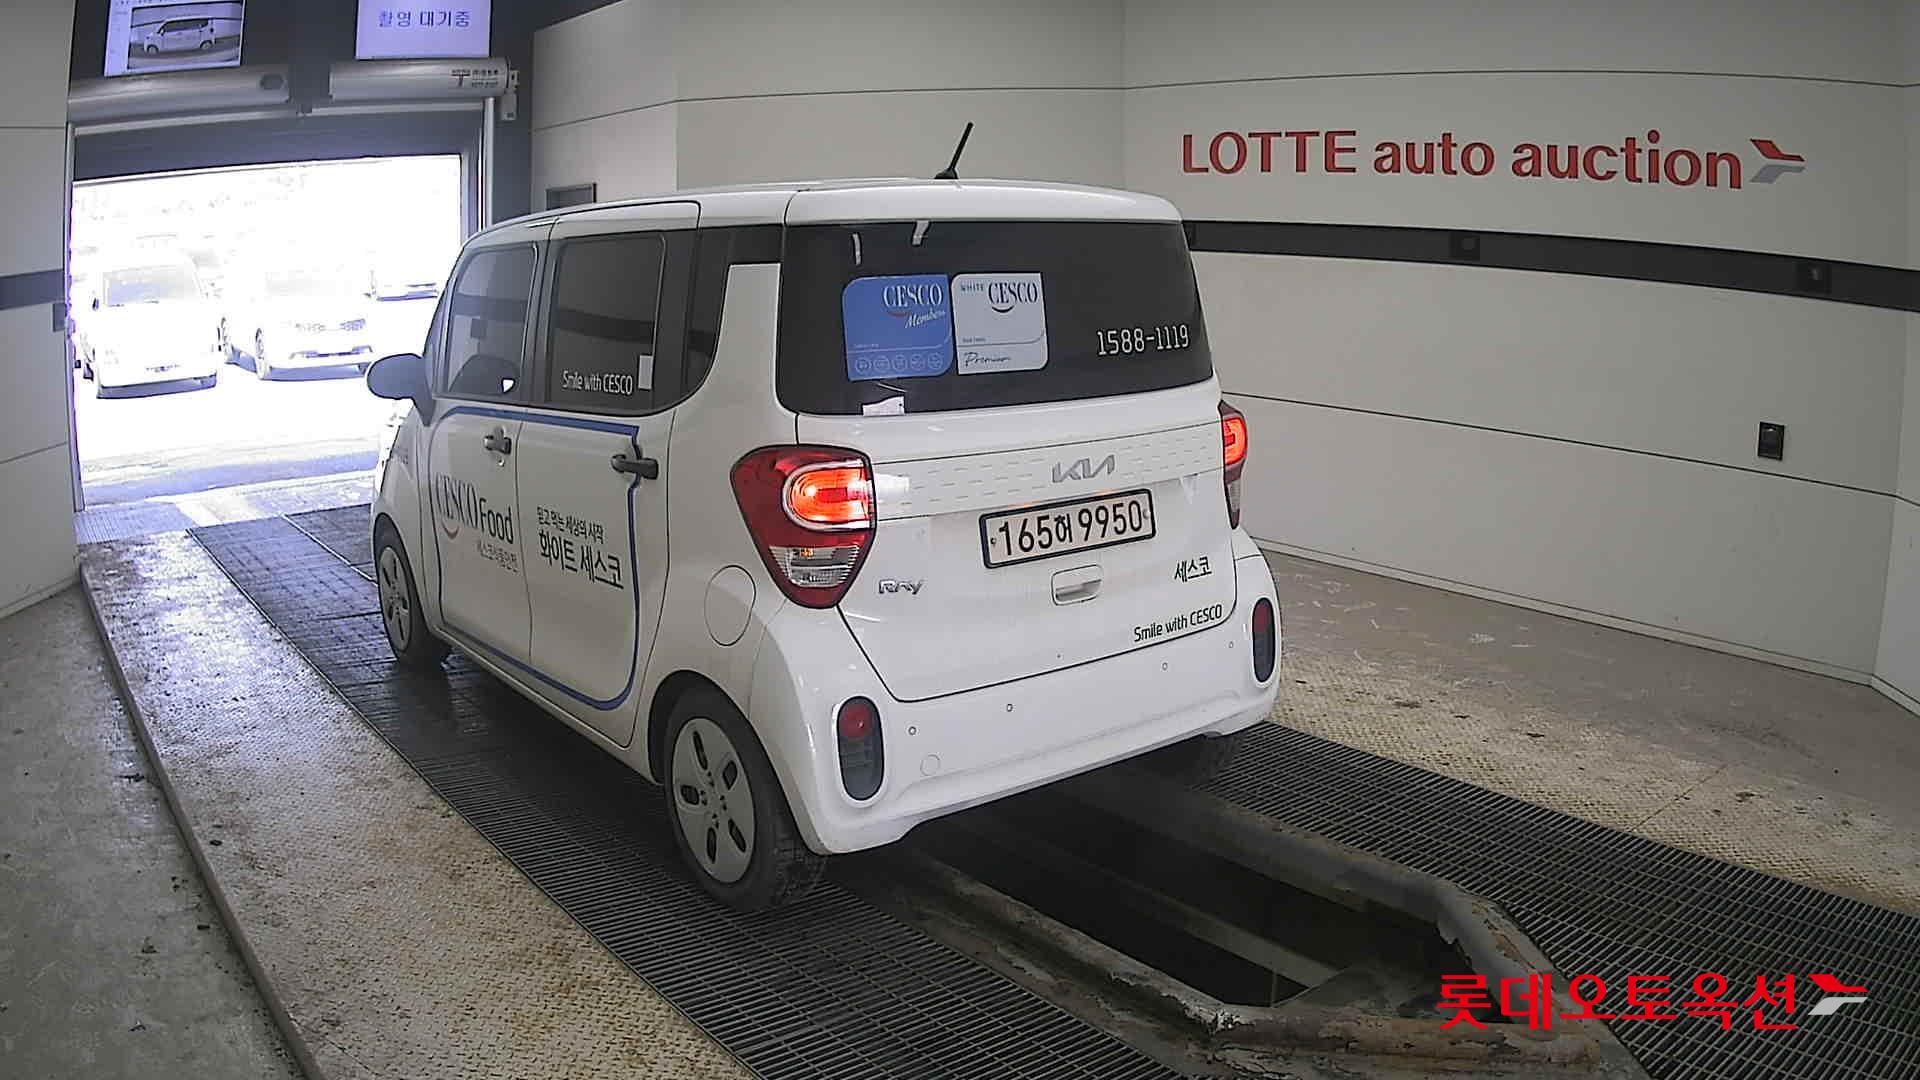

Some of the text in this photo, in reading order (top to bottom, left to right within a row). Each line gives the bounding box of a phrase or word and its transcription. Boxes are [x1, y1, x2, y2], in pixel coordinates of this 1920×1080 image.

[419, 10, 470, 28] 대기중
[1183, 129, 1742, 190] LOTTE auto auction
[883, 282, 943, 308] CESCO
[988, 282, 1038, 304] CESCO
[1097, 324, 1189, 356] 1588-1119
[562, 370, 633, 395] Smile with CESCO
[435, 472, 514, 544] CESCO Food
[998, 500, 1143, 556] 165허 9950
[538, 528, 624, 590] 화이트 세스코
[1174, 555, 1213, 583] 세스코
[1133, 603, 1223, 643] Smile with CESCO
